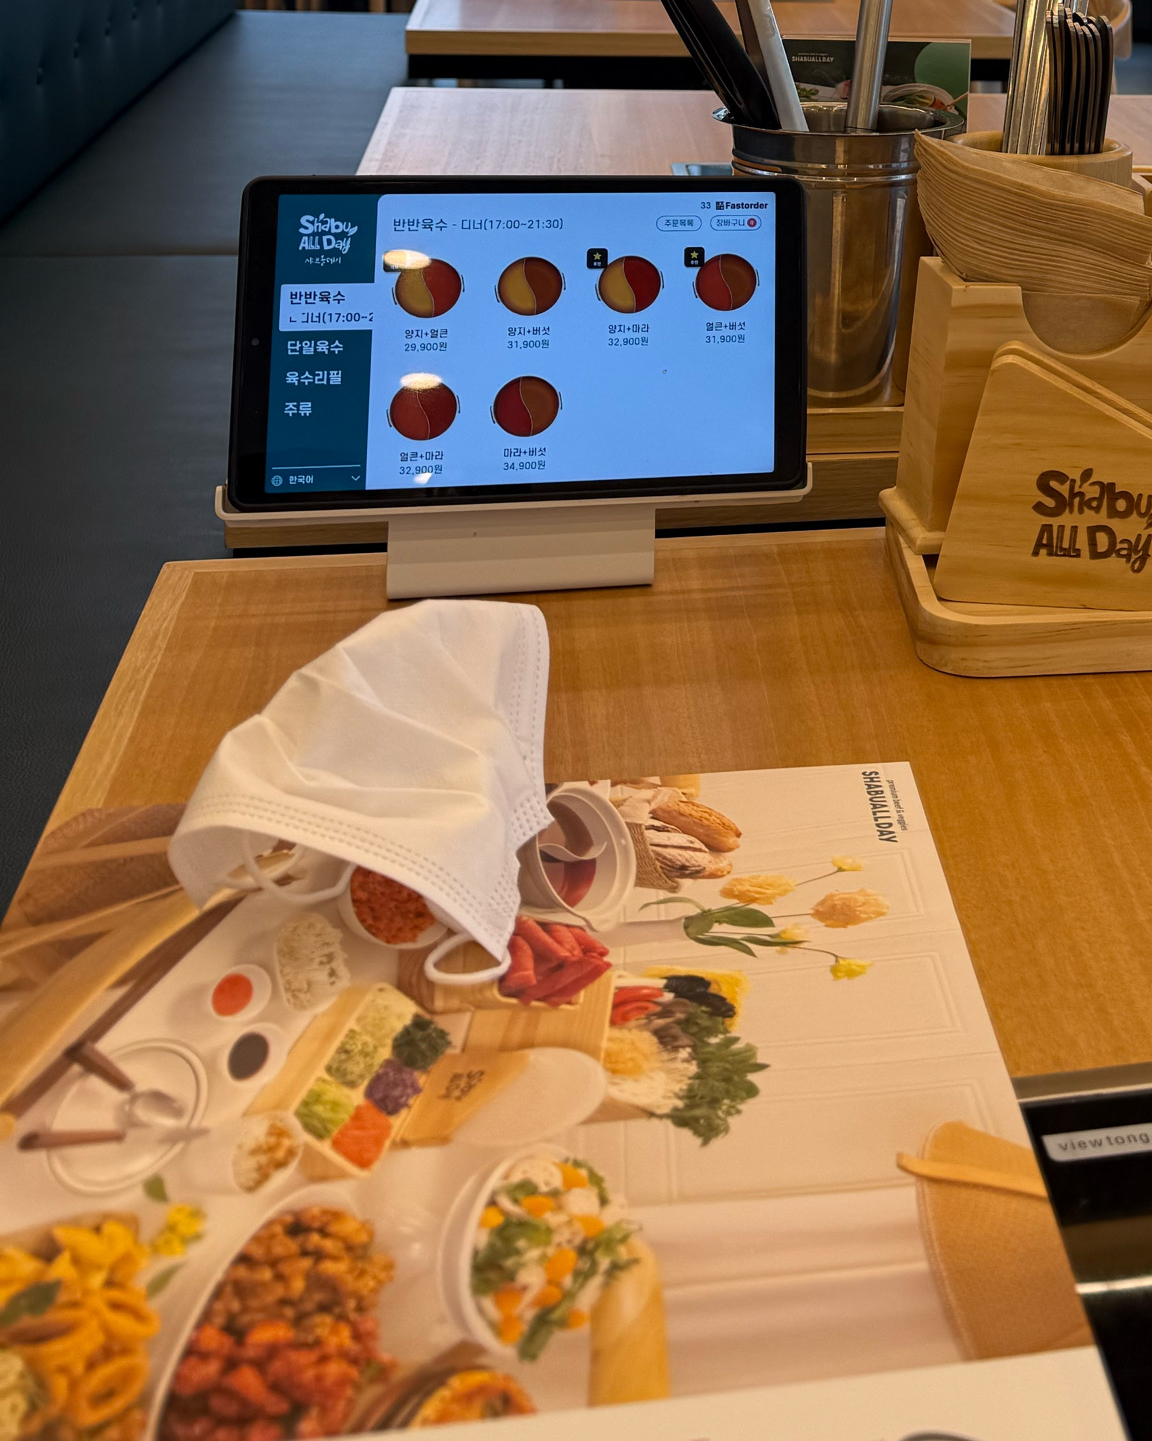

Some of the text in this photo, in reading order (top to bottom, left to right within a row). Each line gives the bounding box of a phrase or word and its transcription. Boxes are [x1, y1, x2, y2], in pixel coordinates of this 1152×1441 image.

[700, 201, 769, 210] 33 Fastorder
[393, 217, 448, 231] 반반육수
[716, 218, 745, 227] 장바구니
[289, 291, 346, 305] 반반육수
[507, 326, 550, 337] 양지+버섯
[608, 323, 649, 334] 양지+마라
[705, 321, 746, 332] 얼큰+버섯
[405, 328, 448, 340] 양지+얼큰
[705, 333, 745, 344] 31,900원
[404, 342, 447, 352] 29,900원
[507, 339, 550, 350] 31,900원
[608, 336, 649, 347] 32,900원
[287, 340, 344, 355] 단일육수
[286, 370, 342, 385] 육수리필
[284, 402, 312, 416] 주류
[400, 451, 444, 462] 얼큰+마라
[503, 447, 546, 458] 마라+버섯
[399, 465, 442, 475] 32,900원
[503, 460, 546, 471] 34,900원
[289, 474, 314, 485] 한국어
[1086, 524, 1152, 574] Day
[861, 770, 898, 843] SHABUALLDAY
[1057, 1131, 1151, 1152] viewtong
